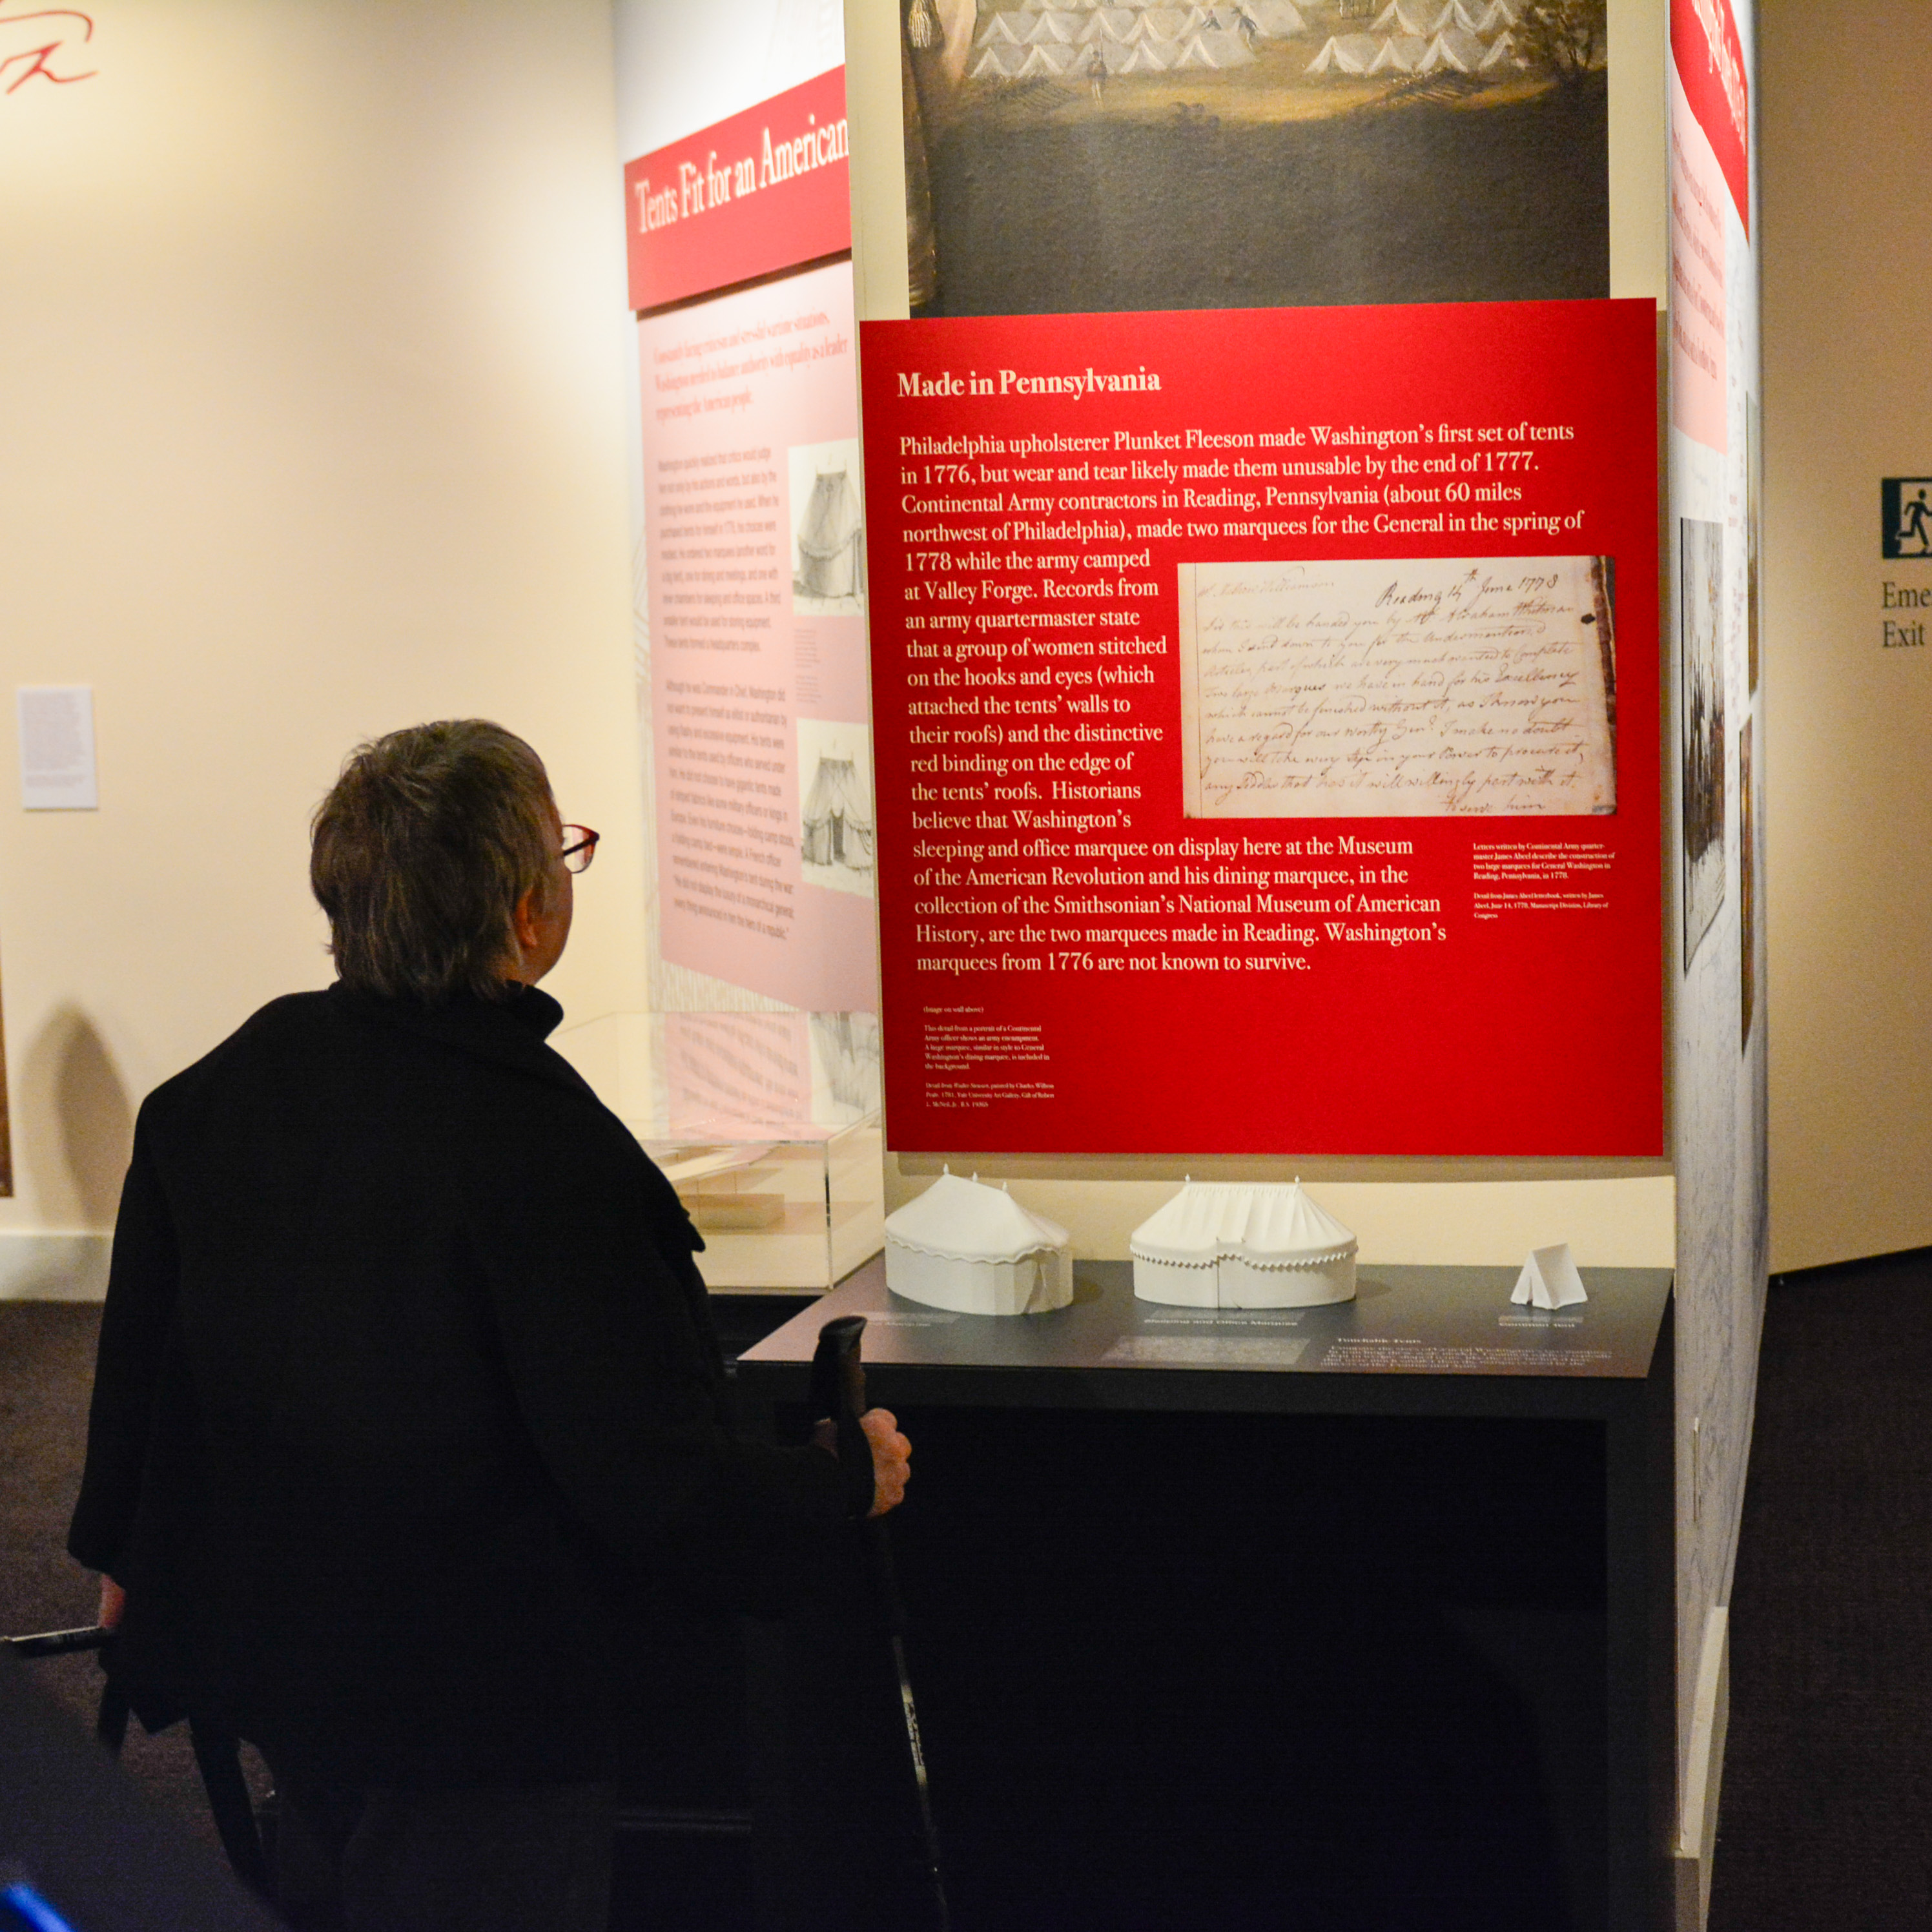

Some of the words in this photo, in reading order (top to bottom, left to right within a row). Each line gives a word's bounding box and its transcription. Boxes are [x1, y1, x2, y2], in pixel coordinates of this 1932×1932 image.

[635, 178, 679, 233] Tents
[680, 161, 706, 219] Fit
[706, 150, 732, 209] for
[734, 156, 757, 198] an
[760, 113, 849, 189] American
[897, 371, 965, 397] Made
[969, 371, 995, 395] in
[998, 365, 1162, 400] Pennsylvania
[899, 435, 1007, 460] Philadelphia
[1009, 433, 1110, 458] upholsterer
[1113, 430, 1182, 451] Plunket
[1185, 429, 1255, 449] Fleeson
[1259, 427, 1306, 447] made
[1308, 424, 1434, 450] Washington’s
[1438, 423, 1474, 443] first
[1477, 426, 1504, 442] set
[1507, 421, 1528, 441] of
[1530, 425, 1574, 441] tents
[901, 466, 918, 484] in
[924, 464, 976, 486] 1776,
[980, 464, 1010, 483] but
[1012, 468, 1054, 482] wear
[1058, 461, 1090, 481] and
[1093, 466, 1128, 480] tear
[1131, 459, 1178, 485] likely
[1182, 458, 1229, 478] made
[1233, 457, 1278, 477] them
[1282, 455, 1361, 477] unusable
[1365, 455, 1387, 480] by
[1390, 454, 1419, 474] the
[1423, 453, 1456, 473] end
[1460, 451, 1481, 472] of
[1485, 451, 1539, 471] 1777.
[901, 493, 1003, 513] Continental
[1007, 493, 1055, 517] Army
[1058, 494, 1158, 510] contractors
[1162, 489, 1179, 508] in
[1183, 488, 1261, 513] Reading,
[1265, 485, 1380, 511] Pennsylvania
[1383, 484, 1441, 506] (about
[1445, 482, 1471, 502] 60
[1475, 481, 1522, 502] miles
[903, 523, 988, 542] northwest
[991, 521, 1011, 540] of
[1013, 519, 1132, 545] Philadelphia),
[1136, 518, 1183, 538] made
[1186, 522, 1219, 537] two
[1223, 521, 1308, 541] marquees
[1311, 515, 1338, 535] for
[1341, 514, 1370, 534] the
[1373, 512, 1444, 533] General
[1448, 513, 1466, 531] in
[1470, 511, 1499, 531] the
[1503, 511, 1561, 536] spring
[1564, 509, 1585, 529] of
[906, 551, 952, 571] 1778
[955, 551, 1002, 570] while
[1005, 550, 1033, 570] the
[1036, 555, 1080, 575] army
[1083, 548, 1151, 573] camped
[904, 586, 921, 601] at
[923, 581, 978, 605] Valley
[981, 579, 1038, 604] Forge.
[1042, 577, 1114, 598] Records
[1118, 577, 1159, 597] from
[1882, 581, 1932, 608] Eme
[1882, 619, 1926, 648] Exit
[912, 811, 972, 829] believe
[975, 810, 1009, 829] that
[1012, 808, 1131, 834] Washington’s
[913, 839, 985, 863] sleeping
[988, 838, 1019, 858] and
[1022, 838, 1071, 857] office
[1074, 843, 1149, 862] marquee
[1152, 843, 1175, 856] on
[1178, 837, 1240, 861] display
[1242, 836, 1282, 856] here
[1286, 841, 1303, 856] at
[1306, 836, 1334, 856] the
[1338, 836, 1413, 855] Museum
[914, 867, 933, 885] of
[935, 867, 961, 886] the
[965, 868, 1047, 885] American
[1051, 866, 1145, 885] Revolution
[1149, 866, 1180, 885] and
[1184, 865, 1209, 885] his
[1213, 865, 1271, 890] dining
[1273, 870, 1355, 890] marquee,
[1359, 865, 1377, 884] in
[1380, 864, 1409, 884] the
[914, 896, 998, 914] collection
[1002, 895, 1022, 914] of
[1022, 895, 1050, 914] the
[1054, 894, 1175, 914] Smithsonian’s
[1178, 894, 1252, 913] National
[1256, 894, 1331, 913] Museum
[1334, 893, 1355, 913] of
[1355, 893, 1441, 912] American
[916, 924, 985, 948] History,
[989, 929, 1015, 942] are
[1019, 923, 1046, 942] the
[1050, 928, 1082, 942] two
[1085, 929, 1168, 947] marquees
[1171, 923, 1218, 942] made
[1222, 923, 1239, 941] in
[1242, 922, 1320, 947] Reading.
[1323, 921, 1446, 947] Washington’s
[917, 958, 998, 976] marquees
[1002, 952, 1042, 971] from
[1048, 952, 1094, 971] 1776
[1098, 958, 1125, 971] are
[1129, 956, 1158, 971] not
[1161, 952, 1220, 971] known
[1223, 956, 1241, 971] to
[1245, 952, 1311, 971] survive.
